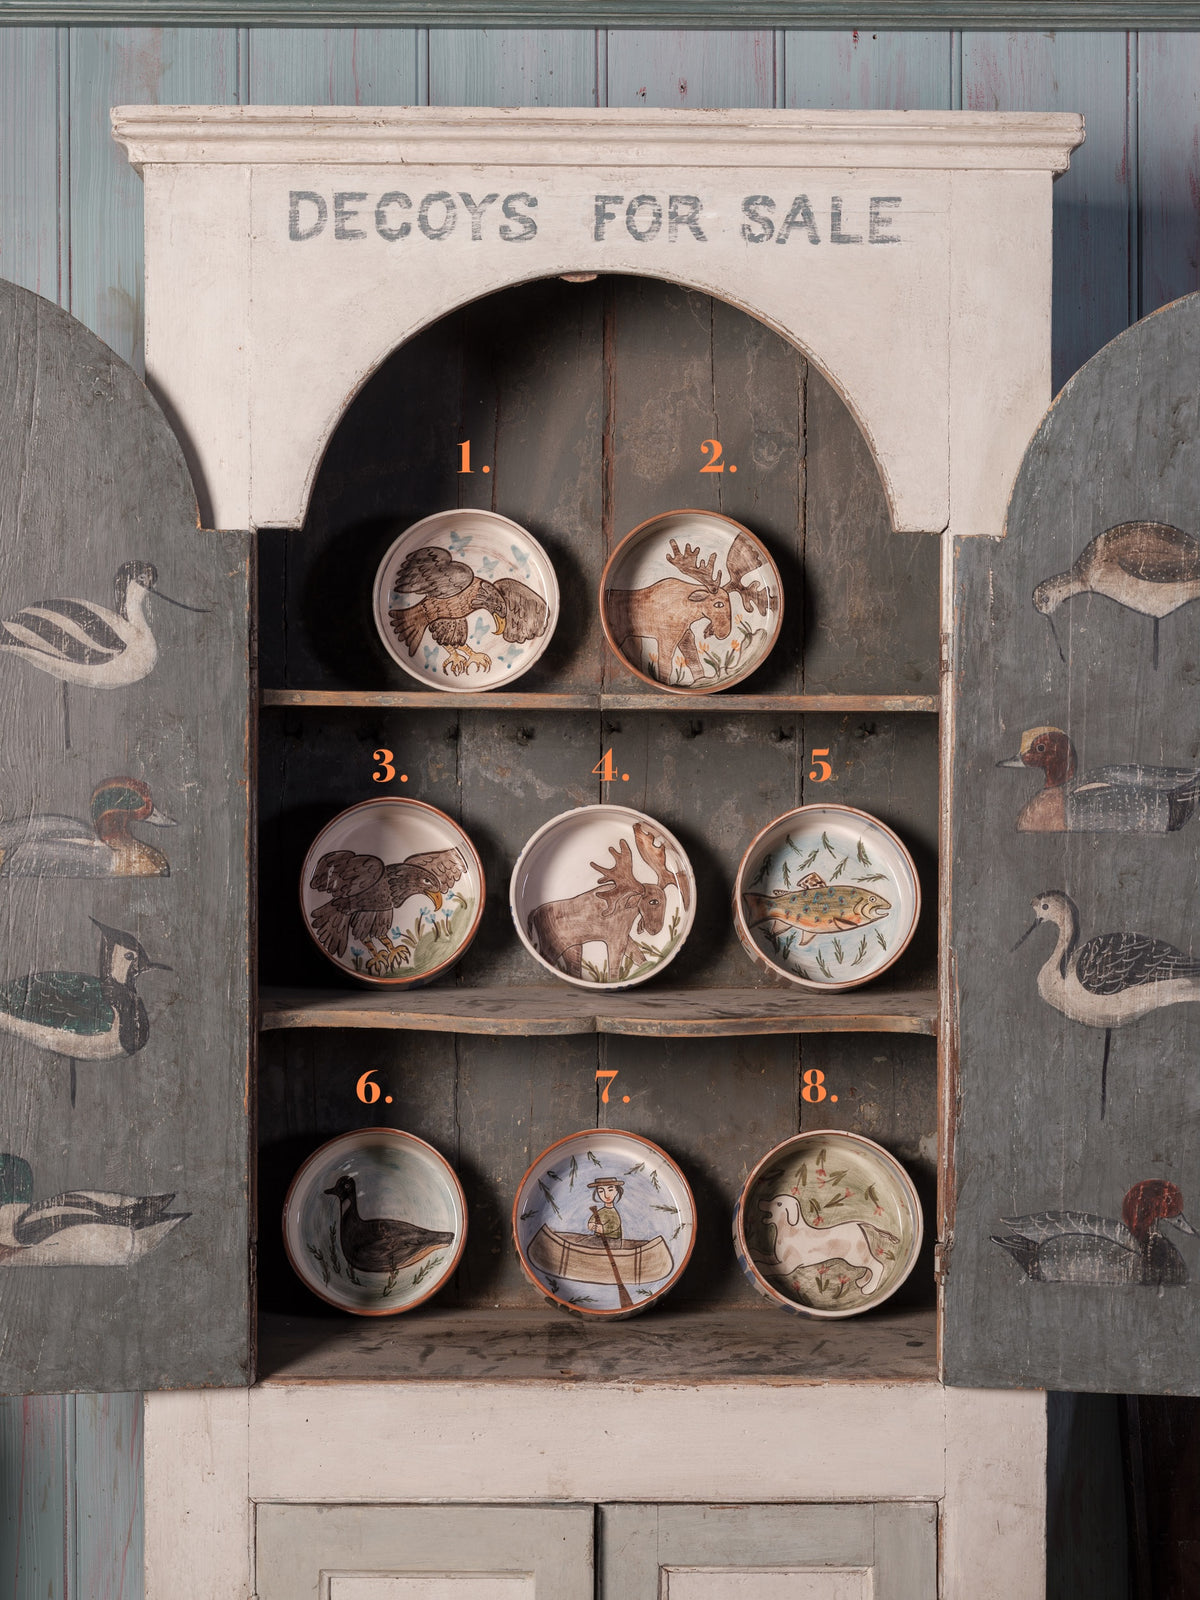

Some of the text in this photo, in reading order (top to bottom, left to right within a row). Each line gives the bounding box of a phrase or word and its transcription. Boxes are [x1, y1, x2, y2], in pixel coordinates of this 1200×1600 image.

[289, 190, 903, 244] DECOYS FOR SALE
